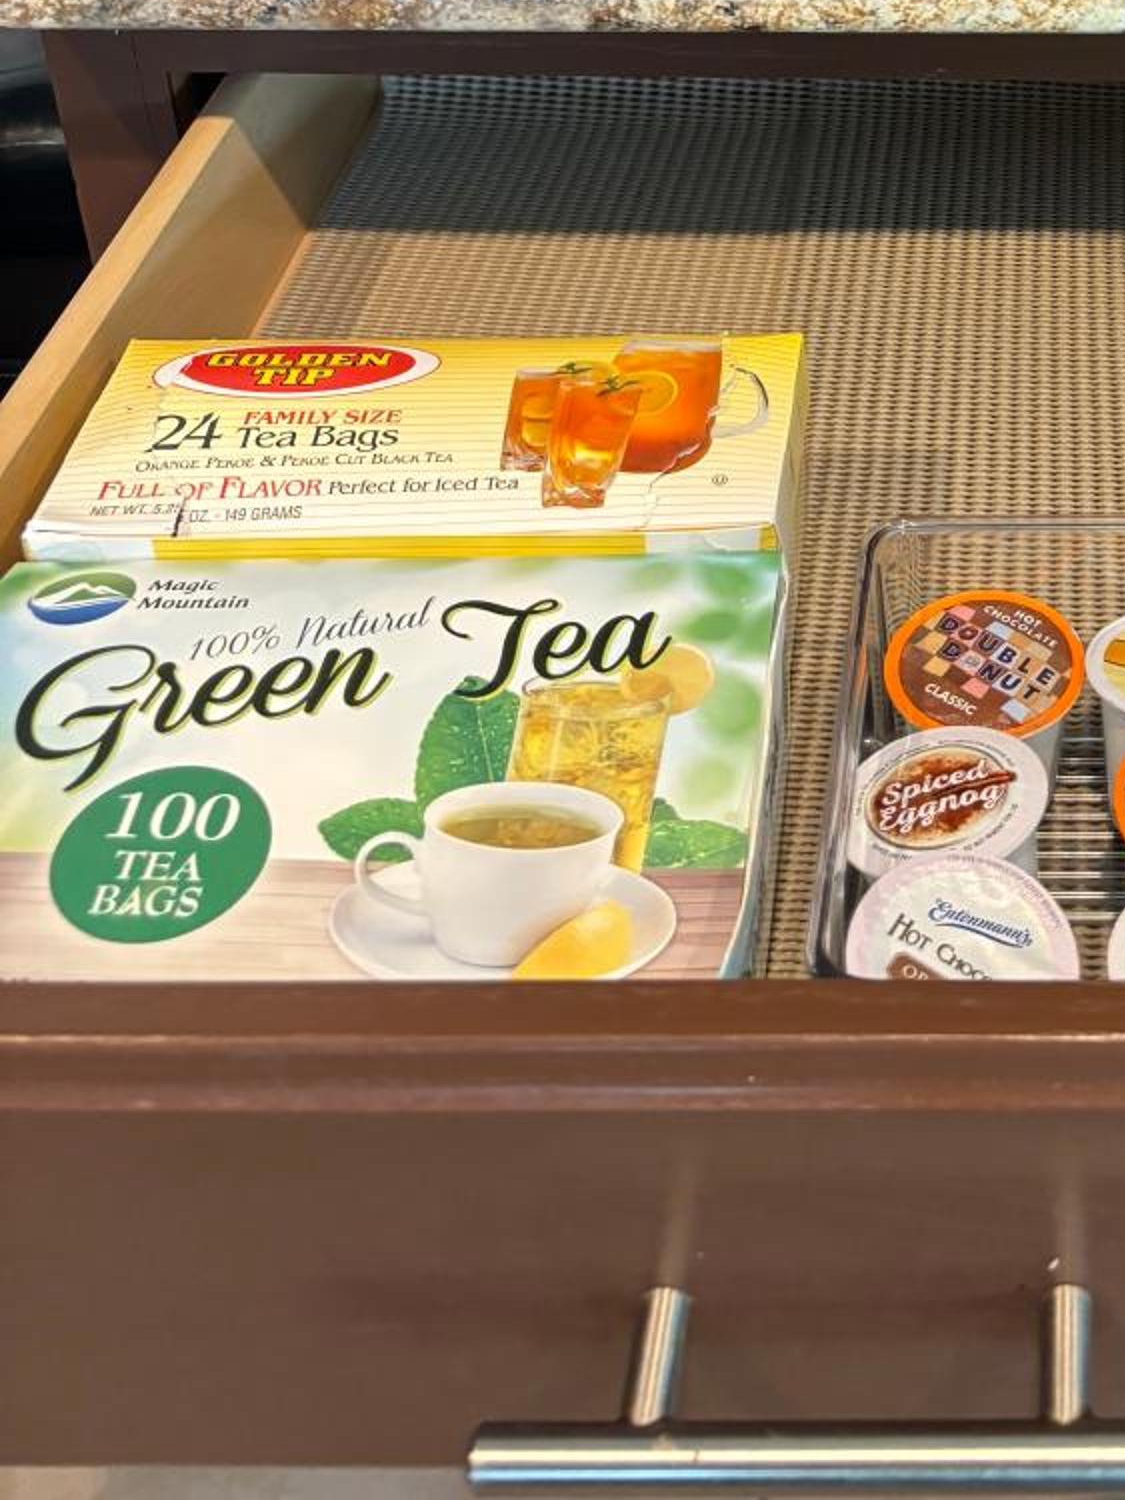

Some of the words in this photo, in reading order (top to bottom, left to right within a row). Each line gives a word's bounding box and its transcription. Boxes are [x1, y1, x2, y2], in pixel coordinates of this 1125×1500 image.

[208, 352, 391, 368] GOLDEN
[254, 367, 335, 386] TIP
[145, 412, 222, 453] 24
[237, 426, 296, 449] Tea
[312, 425, 400, 453] Bags
[244, 410, 336, 425] FAMILY
[343, 409, 402, 424] SIZE
[98, 480, 165, 500] FULL
[219, 475, 322, 500] FLAVOR
[328, 478, 397, 495] Perfect
[403, 477, 430, 493] for
[434, 477, 479, 492] Iced
[484, 476, 520, 491] Tea
[90, 505, 118, 517] NET
[225, 507, 248, 522] 149
[250, 505, 303, 522] GRAMS
[136, 595, 250, 611] Mountain
[148, 578, 218, 595] Magic
[188, 625, 282, 662] 100%
[297, 596, 435, 653] Natural
[983, 604, 1059, 648] CHOCOLATE
[1013, 608, 1042, 628] HOT
[940, 615, 1056, 686] DOUBLE
[942, 640, 1041, 700] DONUT
[14, 642, 395, 792] Green
[440, 596, 673, 699] Tea
[923, 682, 978, 715] CLASSIC
[881, 760, 988, 809] Spiced
[103, 790, 241, 843] 100
[879, 783, 1004, 834] Eggnog
[113, 850, 204, 882] TEA
[88, 882, 204, 921] BAGS
[928, 898, 1034, 947] Entenmann's
